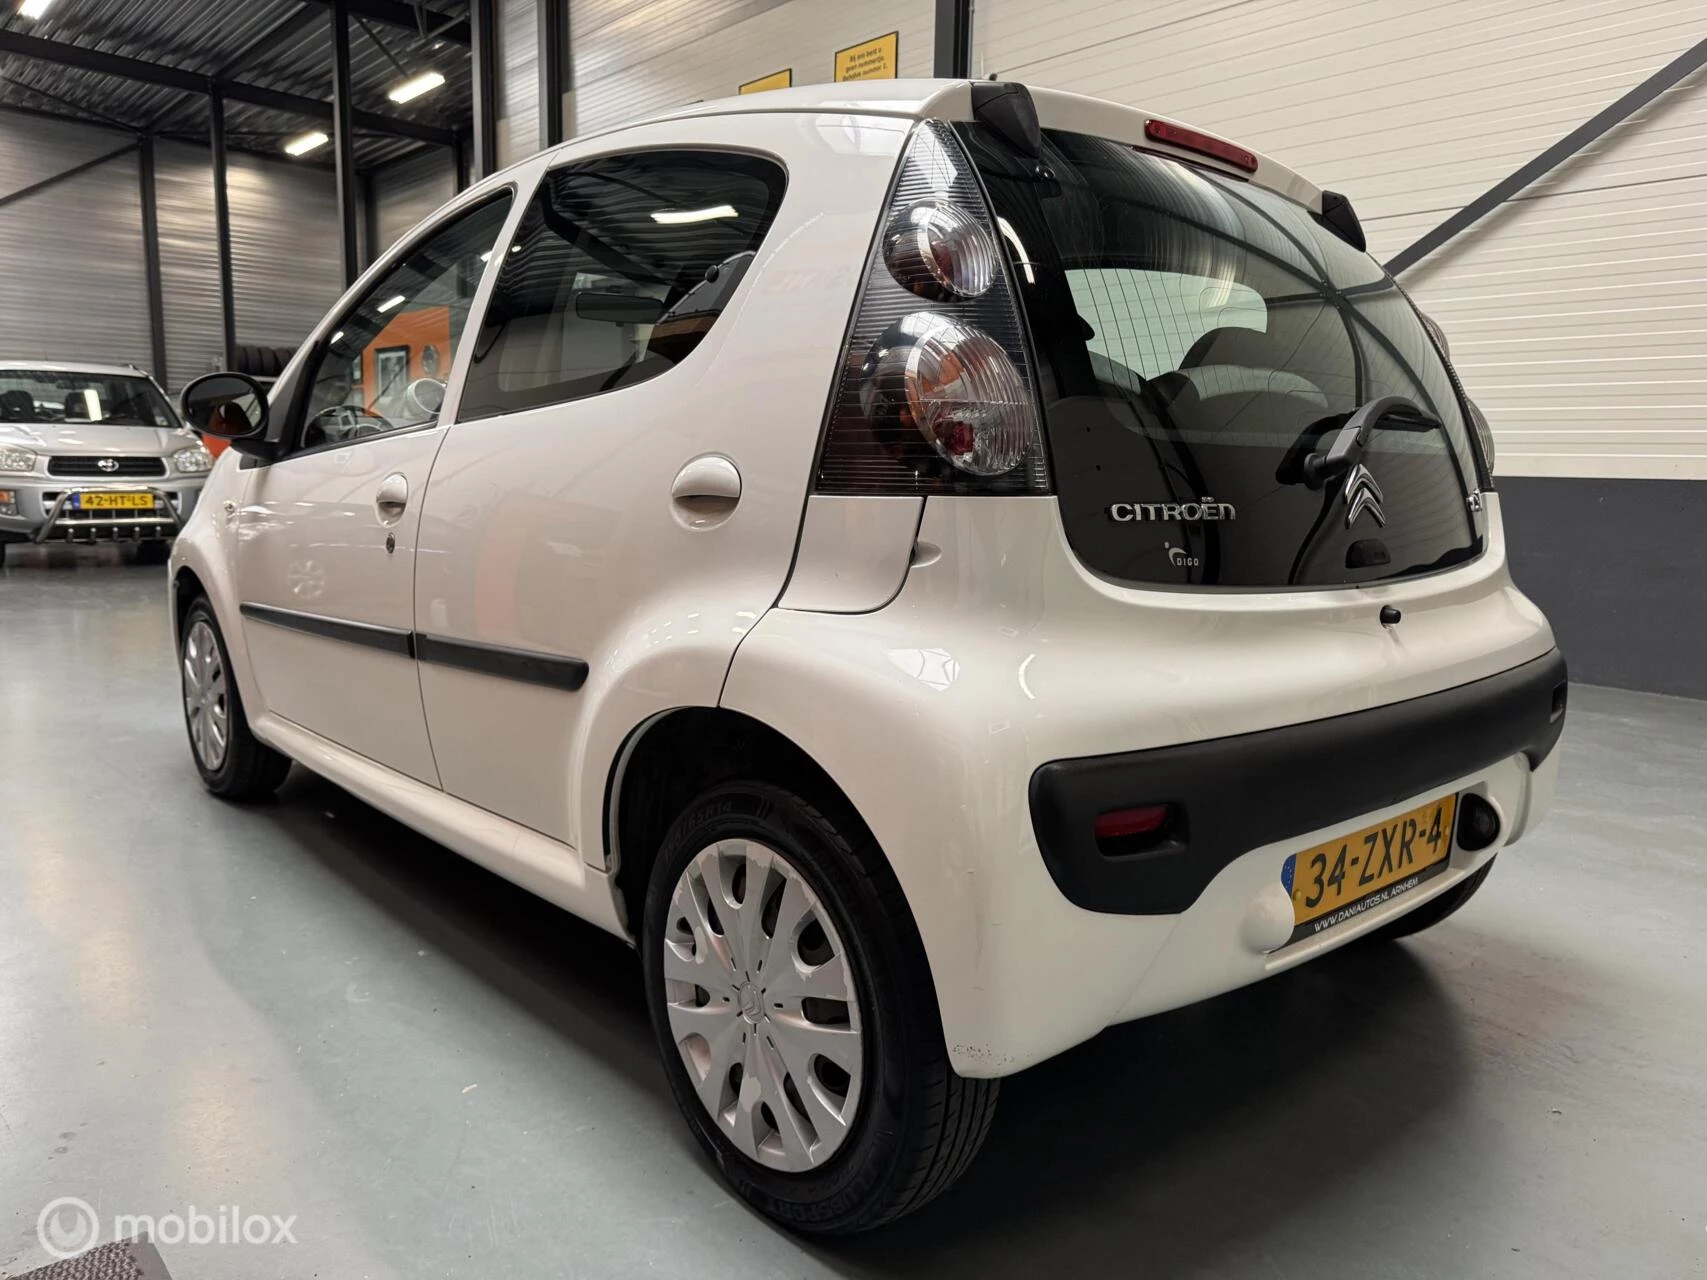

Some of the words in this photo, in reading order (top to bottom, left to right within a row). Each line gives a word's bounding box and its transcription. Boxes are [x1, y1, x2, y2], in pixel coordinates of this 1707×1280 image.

[85, 495, 149, 506] 42-HT-LS
[1305, 804, 1442, 909] 34-ZXR-4
[1314, 892, 1389, 932] WWW.DANIAUTOS.NL
[1390, 877, 1418, 900] ARNHEM
